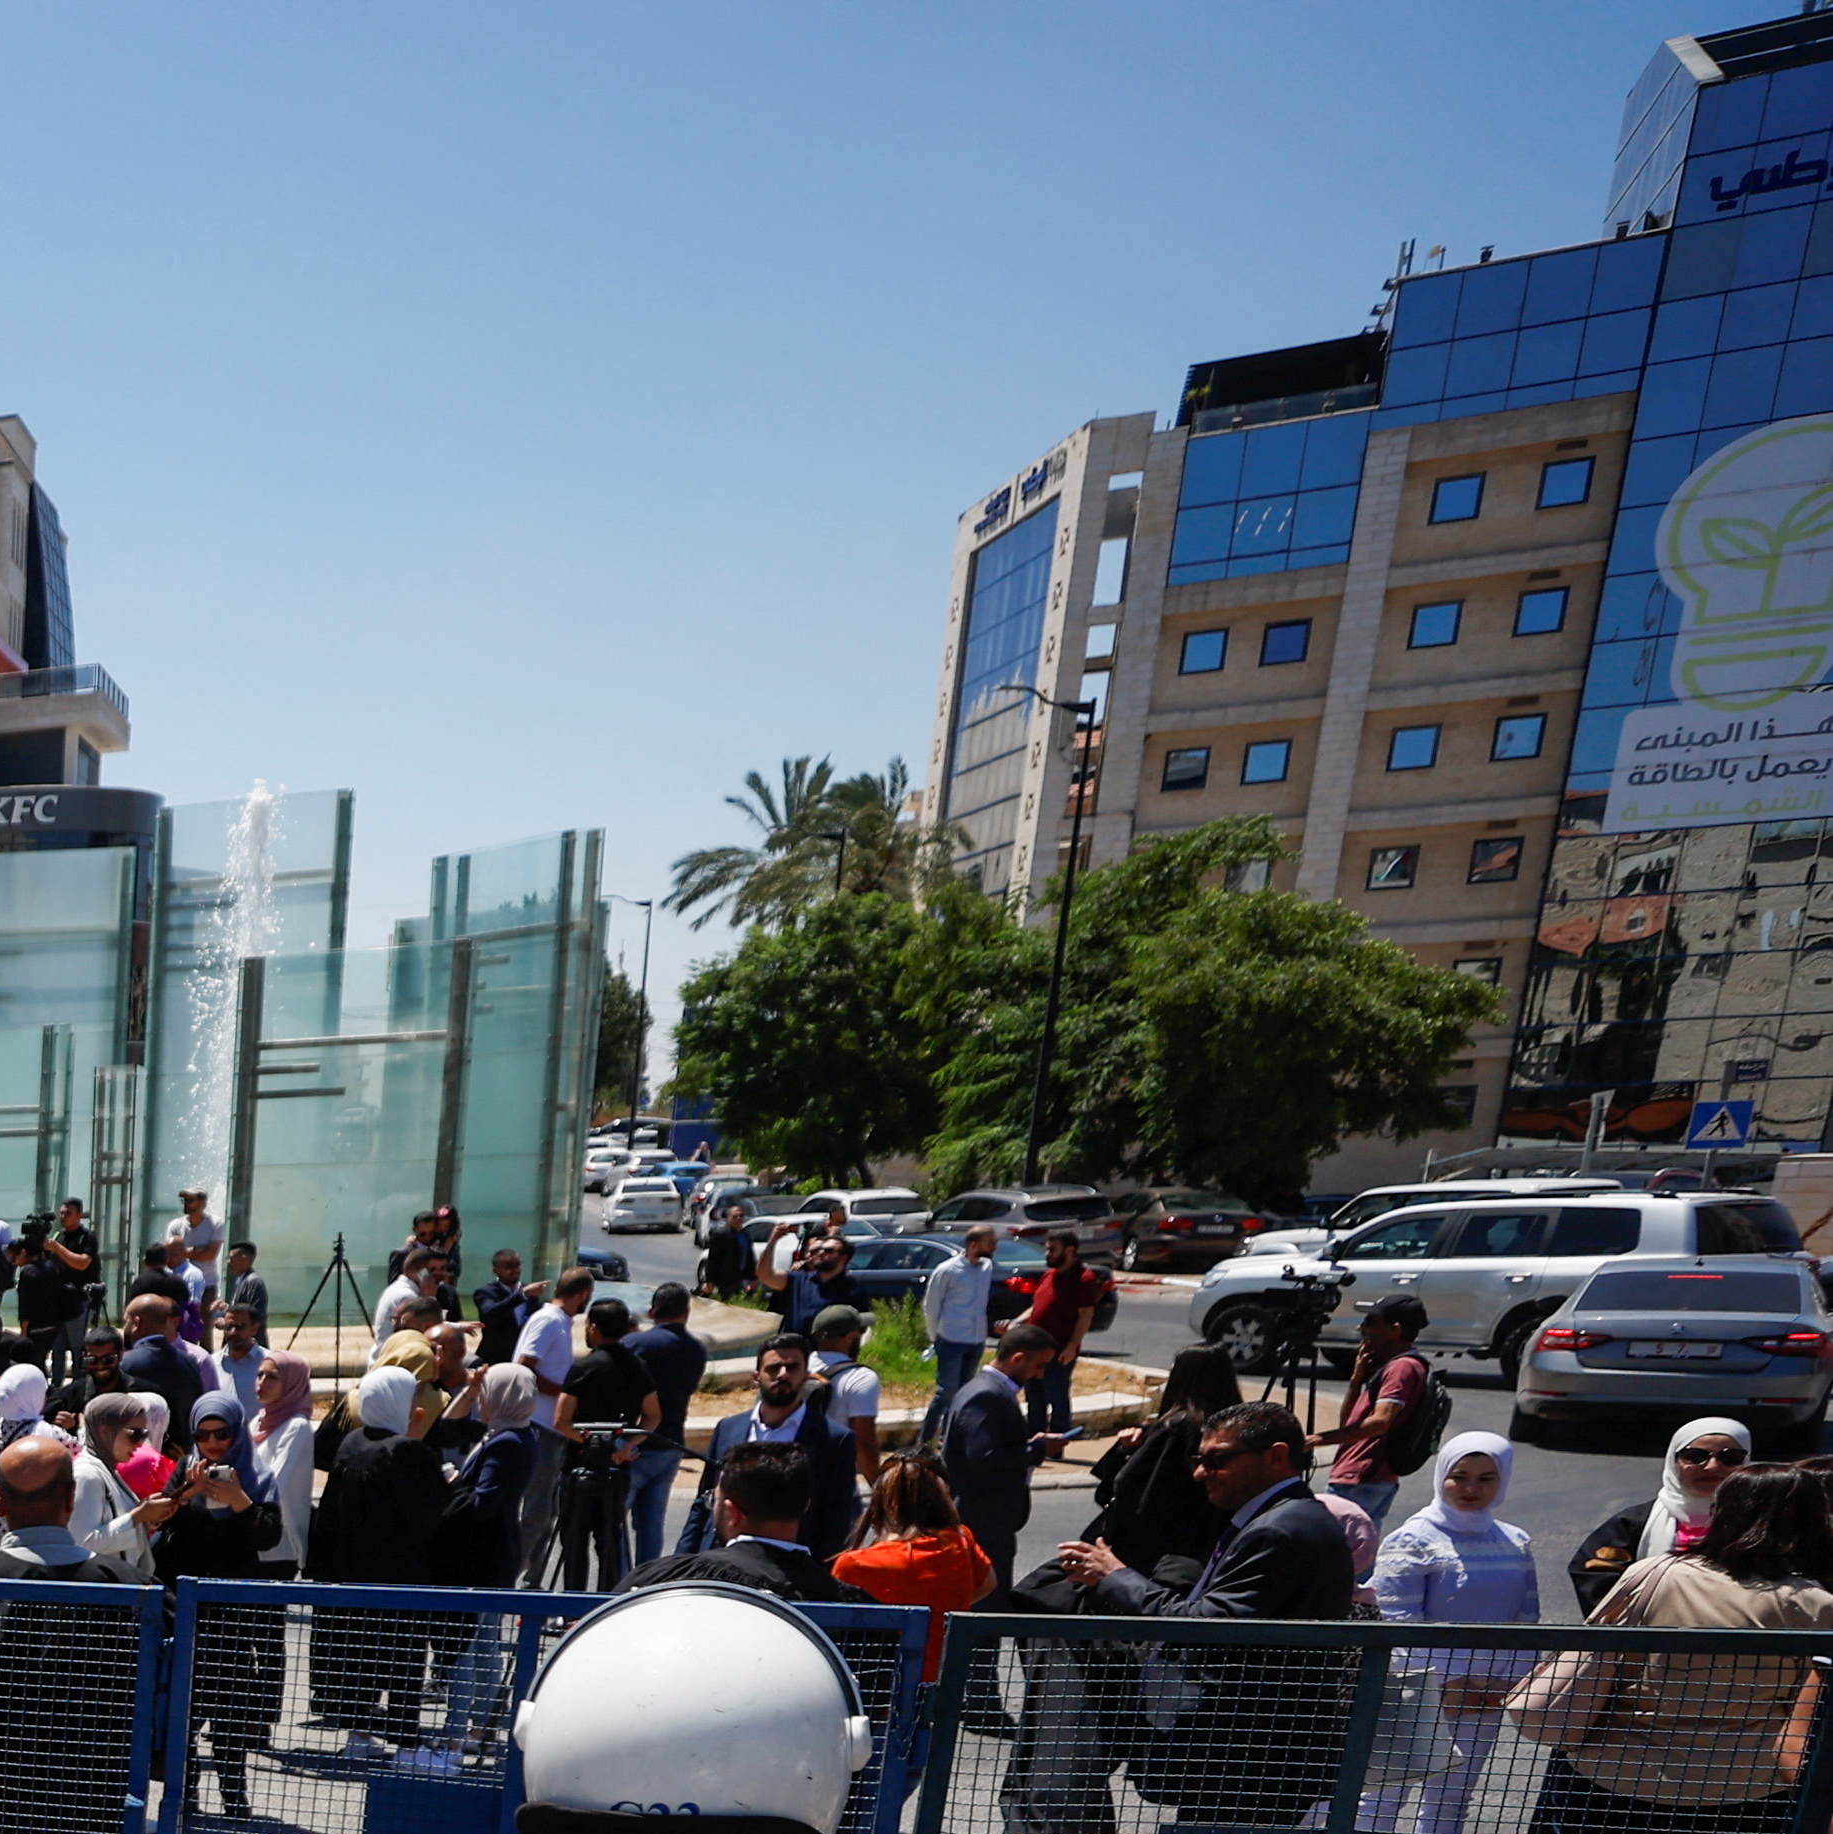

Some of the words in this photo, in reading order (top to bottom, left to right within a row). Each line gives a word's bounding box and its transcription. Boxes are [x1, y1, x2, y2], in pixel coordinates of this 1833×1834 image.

[1634, 721, 1744, 752] المبنى
[1628, 757, 1738, 787] بالطاقة
[1745, 754, 1833, 783] يعمل
[1621, 787, 1823, 826] الشمسية
